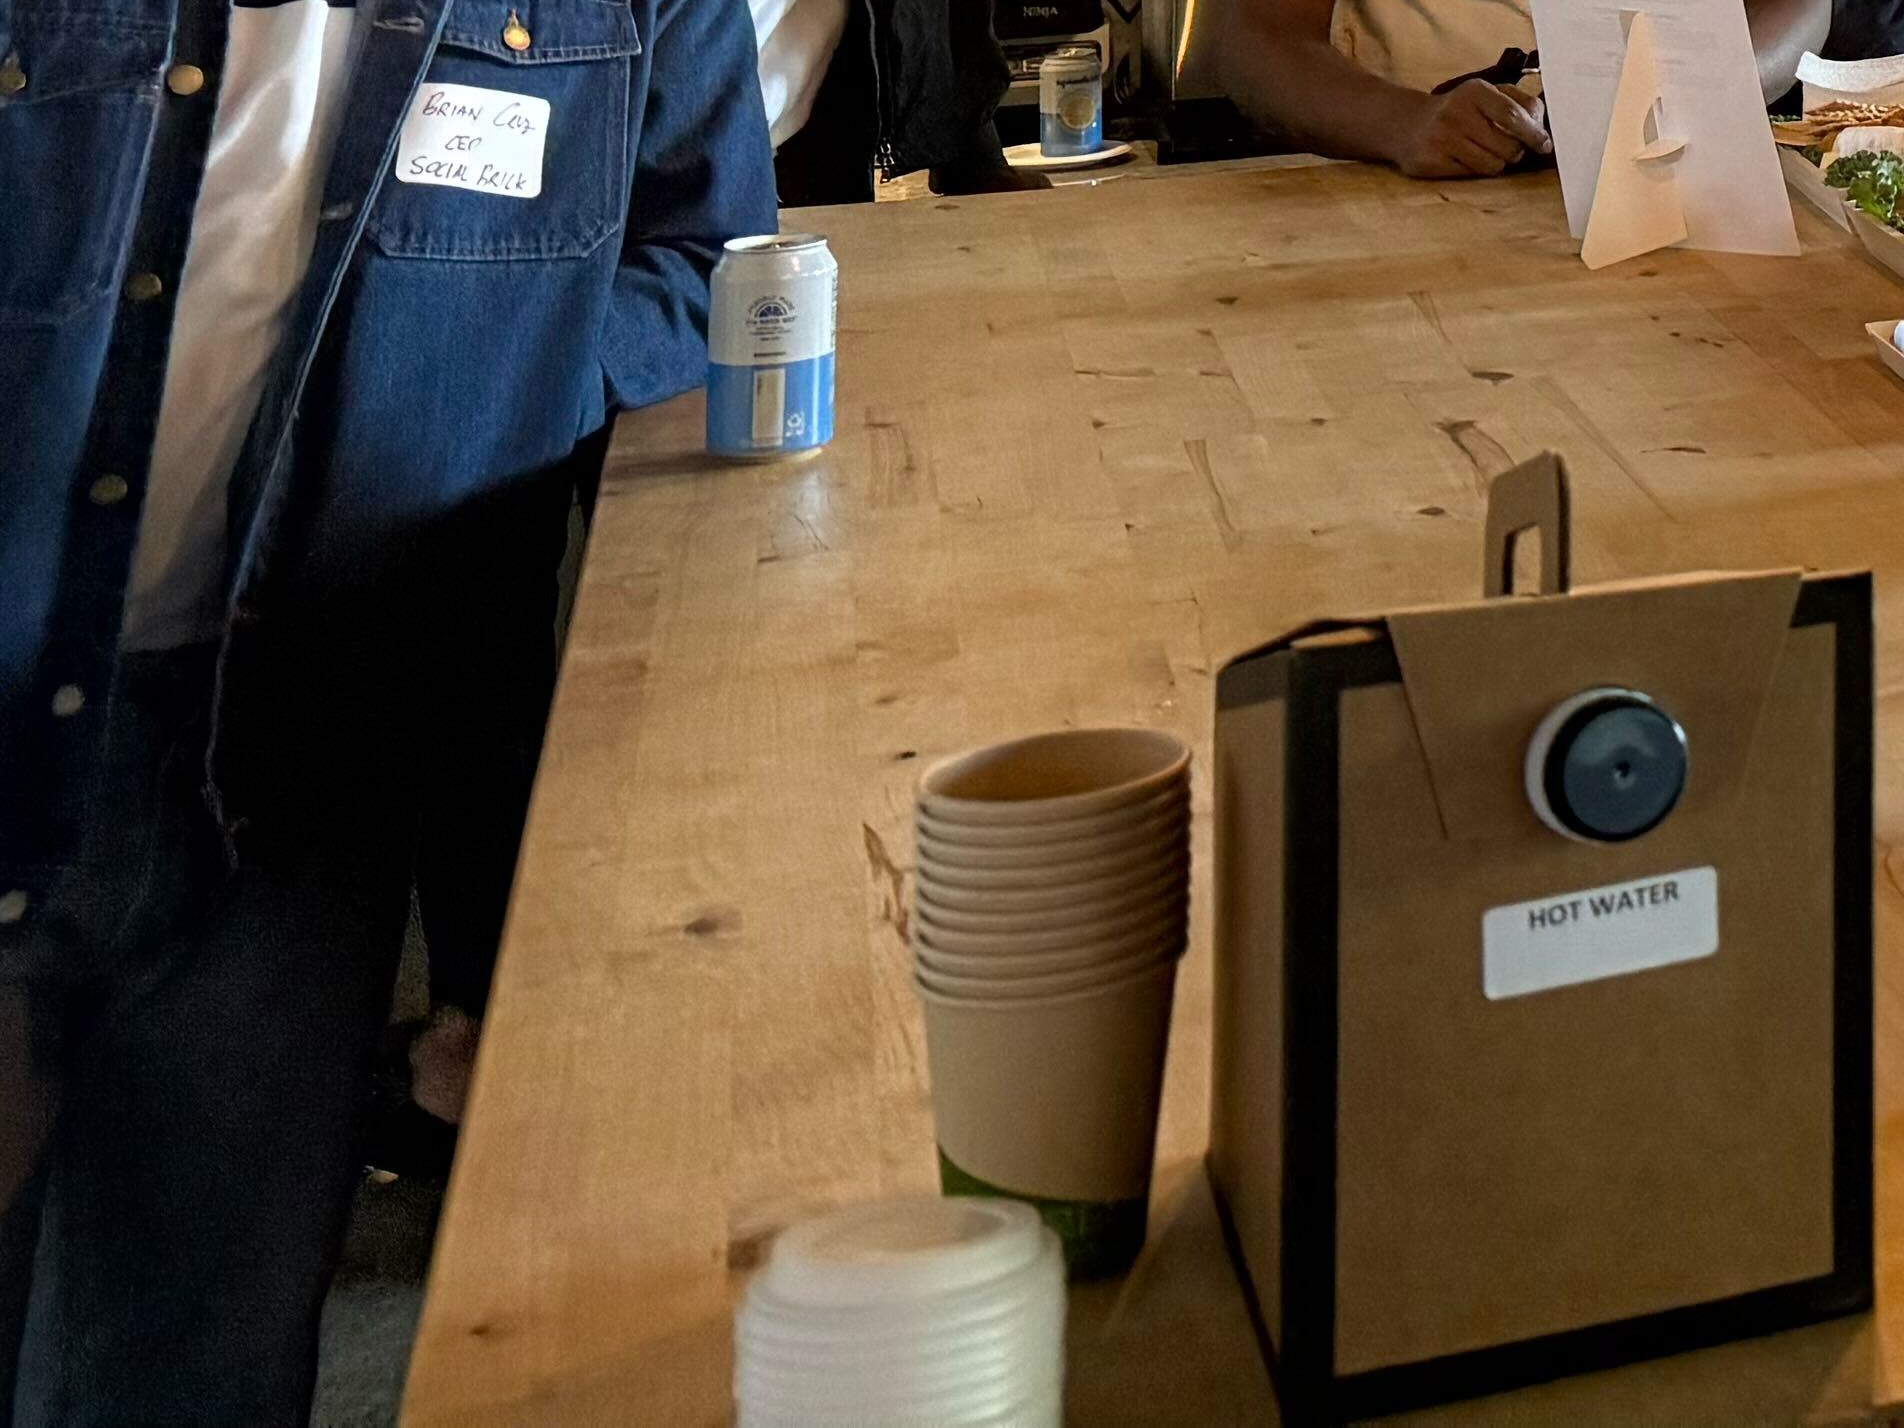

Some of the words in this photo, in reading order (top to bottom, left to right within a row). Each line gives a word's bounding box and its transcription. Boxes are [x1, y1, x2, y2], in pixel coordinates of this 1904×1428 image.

[422, 91, 485, 121] BRIAN
[1528, 901, 1583, 931] HOT
[1589, 880, 1680, 918] WATER
